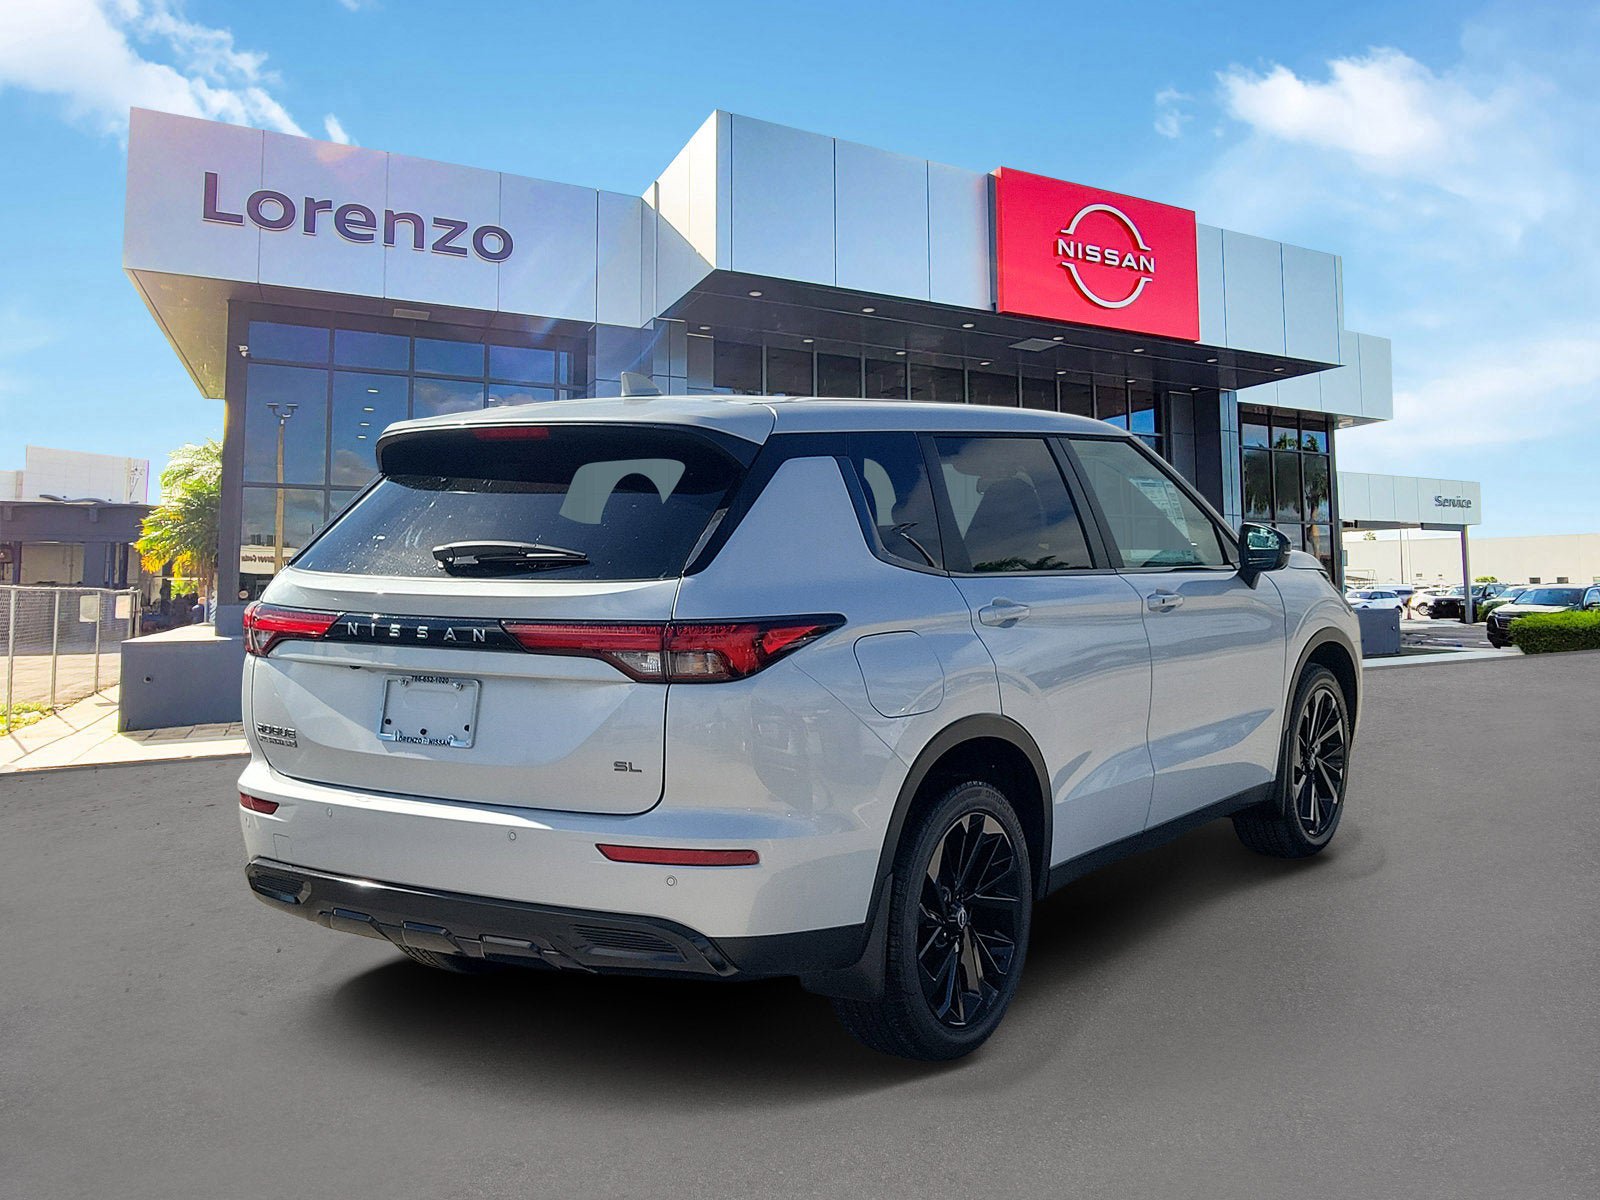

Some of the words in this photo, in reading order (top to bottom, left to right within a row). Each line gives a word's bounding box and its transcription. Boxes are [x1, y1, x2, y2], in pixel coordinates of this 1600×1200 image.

[202, 171, 514, 262] Lorenzo
[1057, 238, 1156, 273] NISSAN
[1434, 495, 1472, 508] Service
[347, 621, 486, 642] NISSAN
[257, 721, 297, 739] ROGUE
[395, 734, 422, 744] LORENZO
[429, 738, 451, 747] NISSAN
[613, 760, 643, 773] SL
